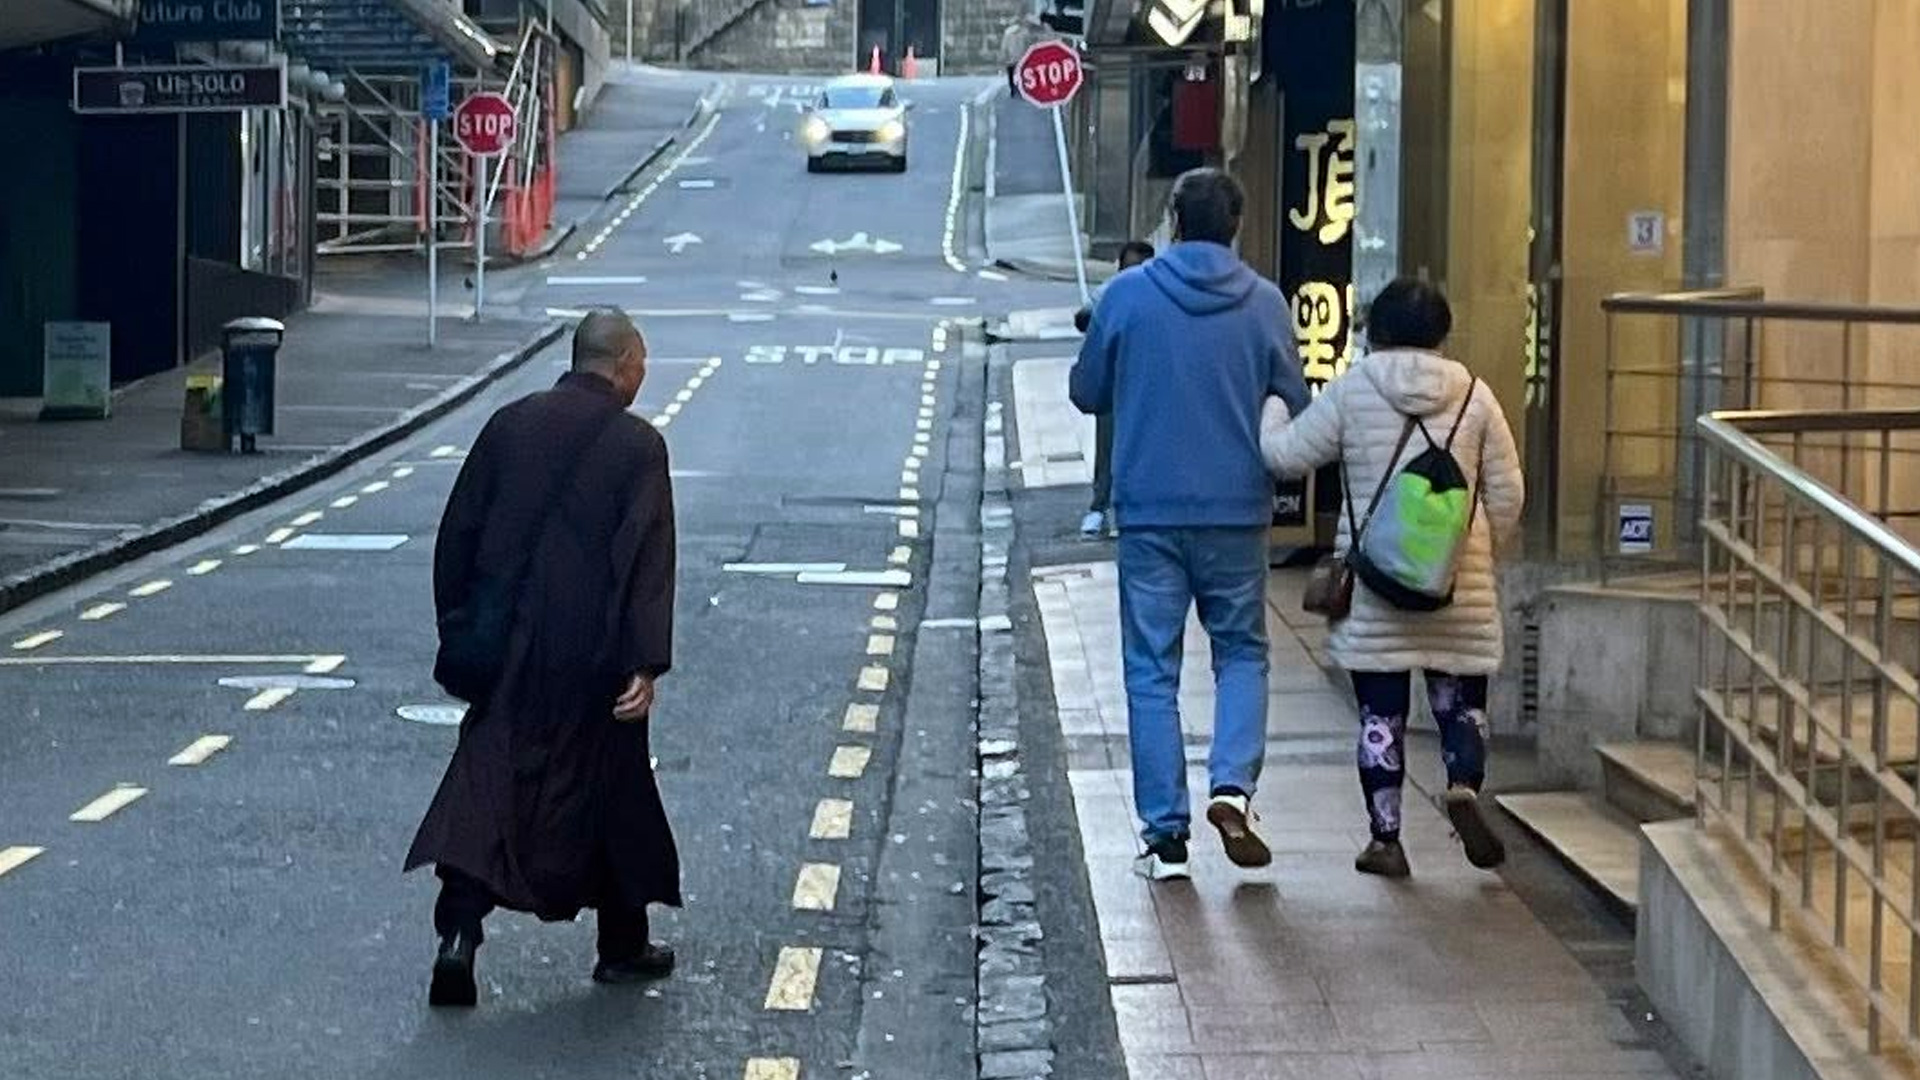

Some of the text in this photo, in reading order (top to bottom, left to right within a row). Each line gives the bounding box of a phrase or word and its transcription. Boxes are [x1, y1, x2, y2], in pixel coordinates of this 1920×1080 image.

[141, 0, 262, 22] uture Club
[1023, 58, 1076, 89] STOP
[459, 113, 512, 136] STOP
[744, 345, 924, 365] STOP
